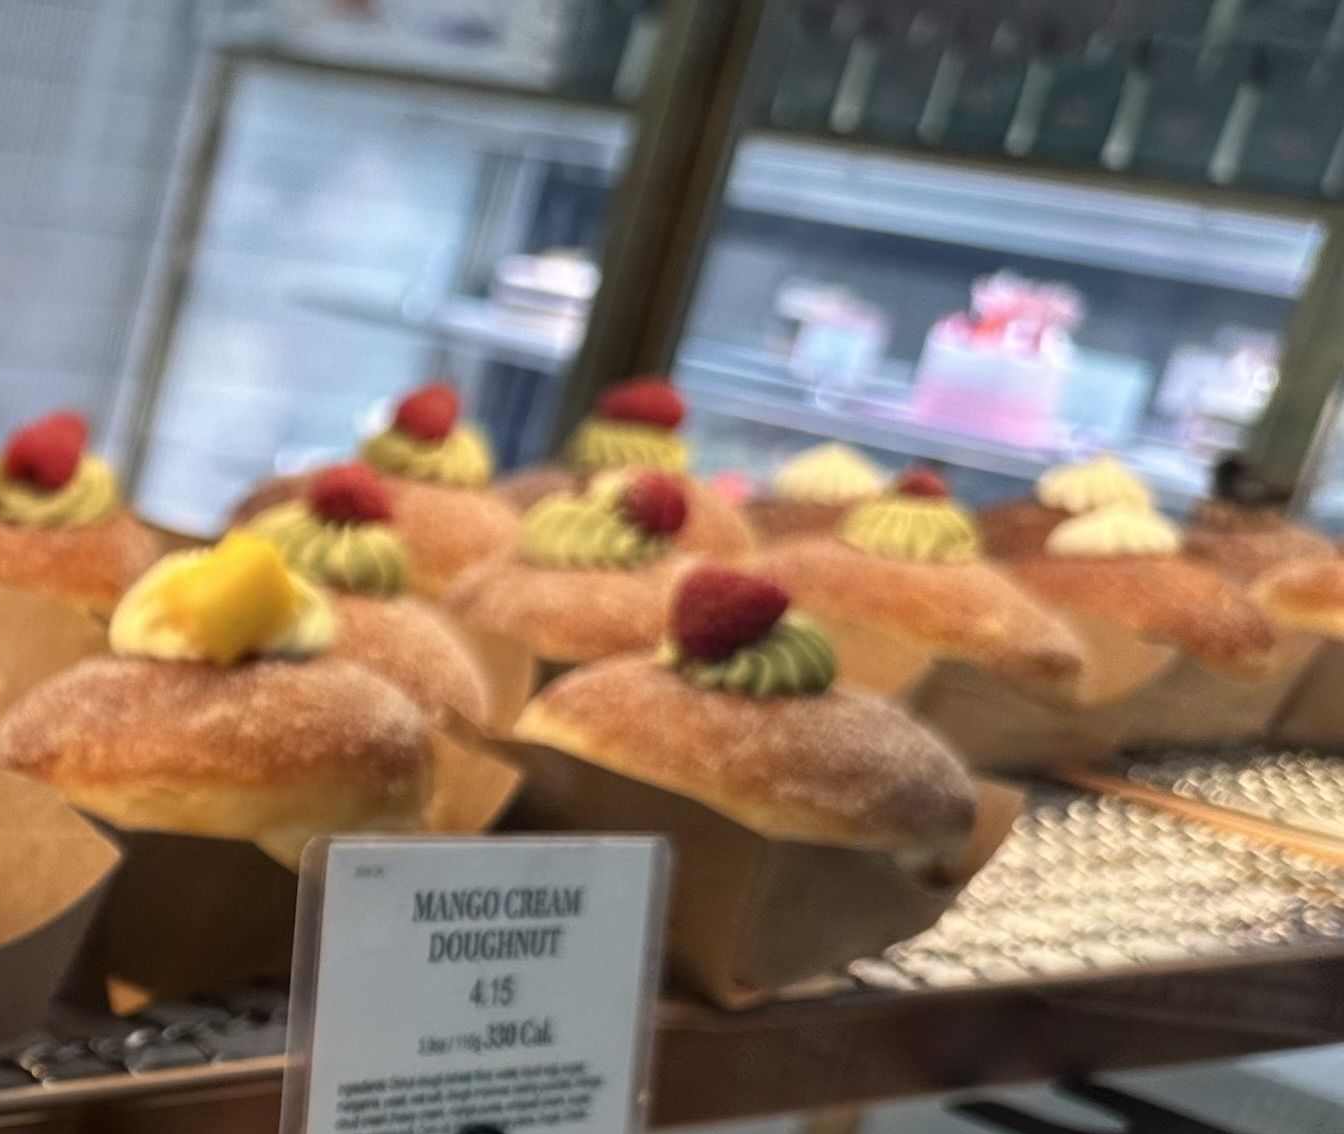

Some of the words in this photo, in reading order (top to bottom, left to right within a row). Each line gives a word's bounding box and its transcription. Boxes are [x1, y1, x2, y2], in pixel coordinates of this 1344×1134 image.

[413, 888, 501, 923] MANGO
[503, 886, 583, 920] CREAM
[427, 928, 562, 964] DOUGHNUT
[468, 974, 516, 1007] 4.15
[484, 1022, 518, 1049] 330
